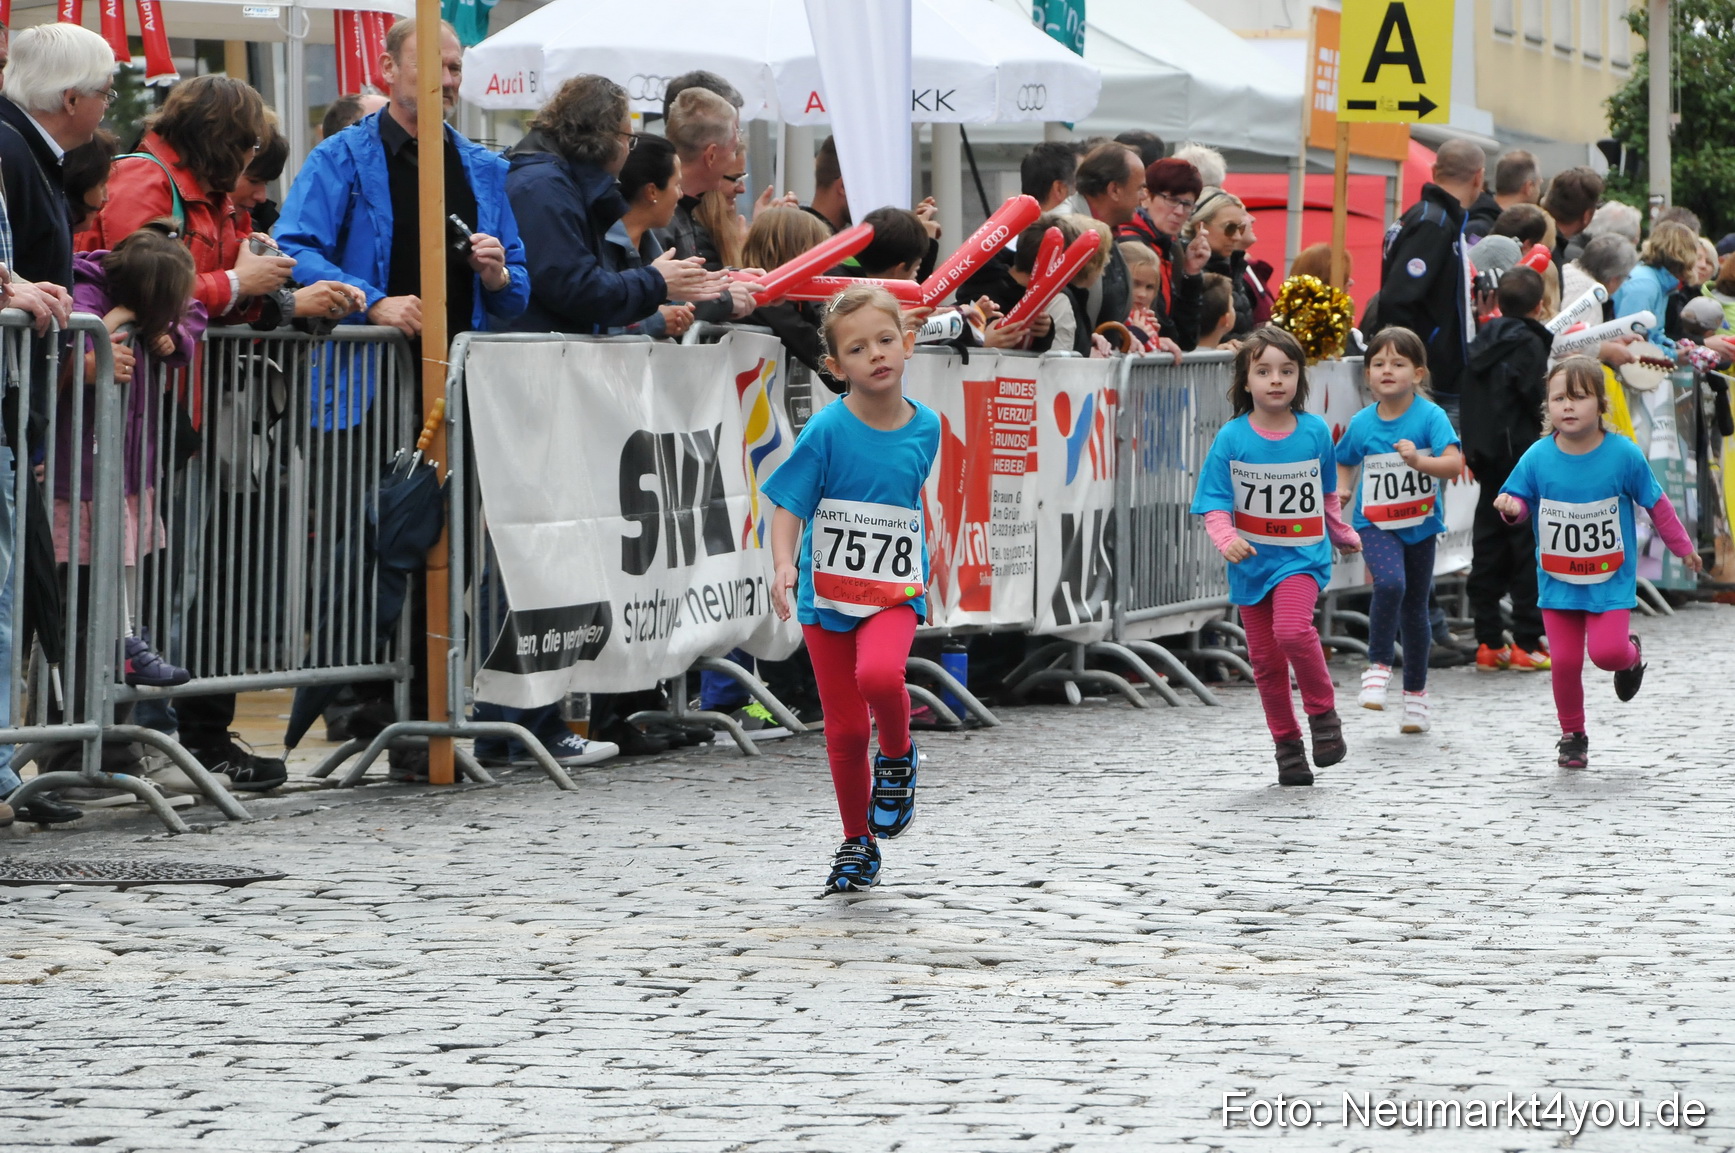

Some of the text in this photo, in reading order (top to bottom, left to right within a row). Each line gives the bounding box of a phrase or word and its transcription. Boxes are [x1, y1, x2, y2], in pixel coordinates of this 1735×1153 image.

[62, 0, 74, 19] Au
[106, 0, 116, 18] Au
[1362, 2, 1426, 84] A
[529, 71, 537, 93] B
[912, 89, 956, 112] KK
[922, 277, 950, 304] Audi
[948, 255, 976, 280] BKK
[999, 381, 1036, 396] BINDES
[995, 432, 1028, 447] RUNDS
[993, 458, 1025, 473] HEBEB
[1232, 468, 1308, 480] PARTL Neumarkt
[1369, 470, 1432, 501] 7046
[1240, 481, 1316, 514] 7128
[816, 508, 907, 530] PARTL Neumarkt
[1386, 506, 1417, 519] Laura
[1541, 507, 1607, 519] PARTL Neumarkt
[1266, 522, 1287, 534] Eva
[1547, 519, 1616, 553] 7035
[823, 527, 913, 578] 7578
[1569, 561, 1595, 575] Anja
[542, 628, 561, 653] die
